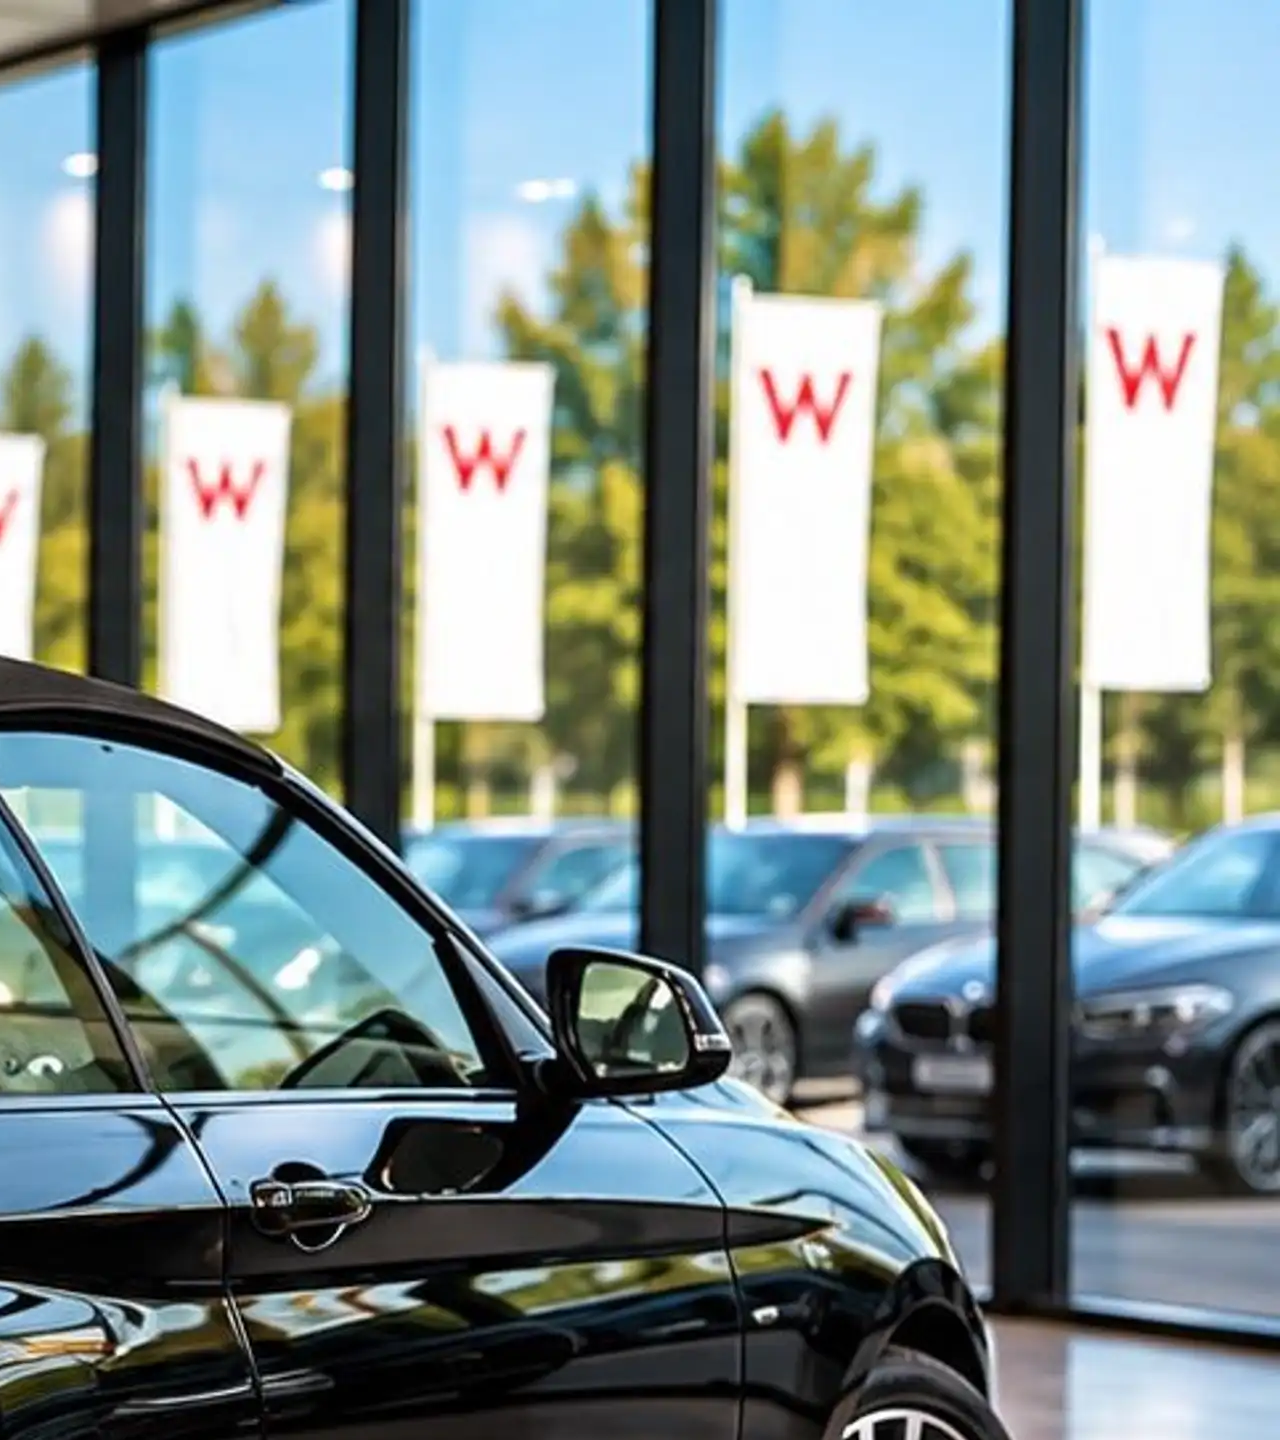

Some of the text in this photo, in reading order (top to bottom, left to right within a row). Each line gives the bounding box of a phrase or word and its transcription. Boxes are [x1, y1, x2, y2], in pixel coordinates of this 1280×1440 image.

[761, 367, 851, 443] W
[1107, 328, 1195, 411] W
[188, 458, 265, 521] W
[444, 424, 526, 495] W
